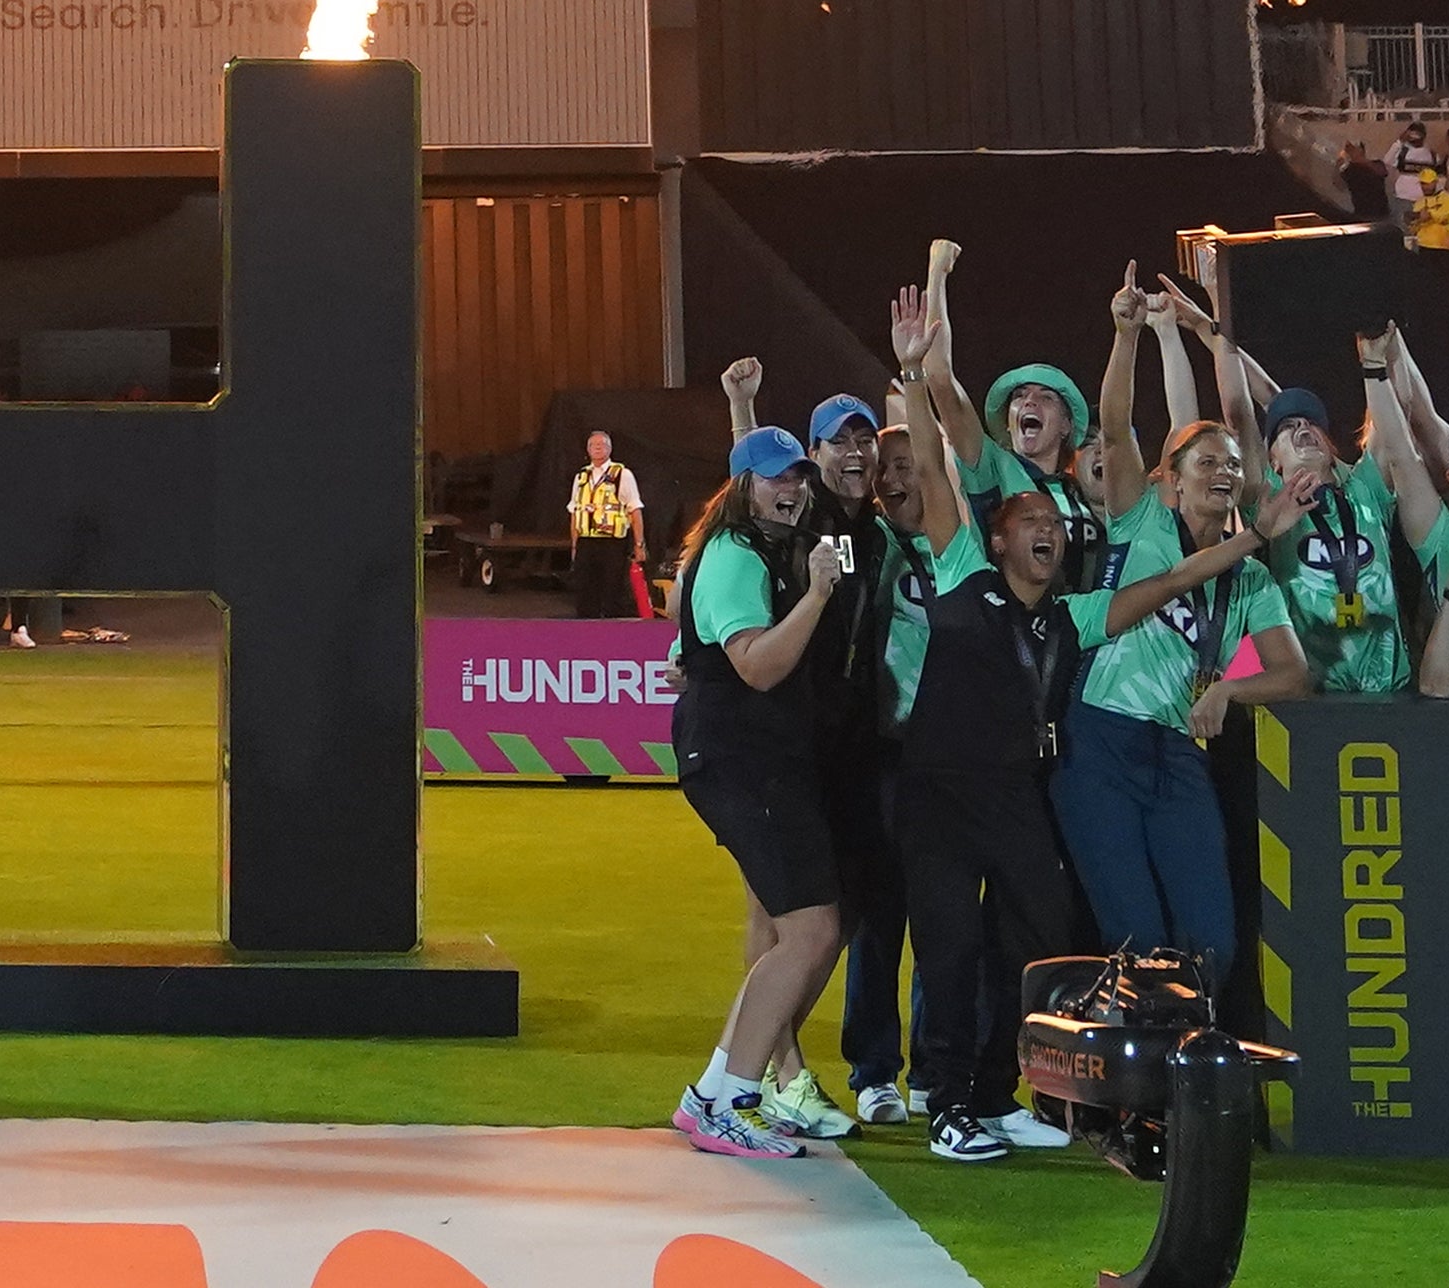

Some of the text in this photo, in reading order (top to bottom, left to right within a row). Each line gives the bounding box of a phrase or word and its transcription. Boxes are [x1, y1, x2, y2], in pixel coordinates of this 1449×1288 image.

[461, 658, 680, 705] HUNDRE
[1338, 742, 1412, 1118] THE HUNDRED
